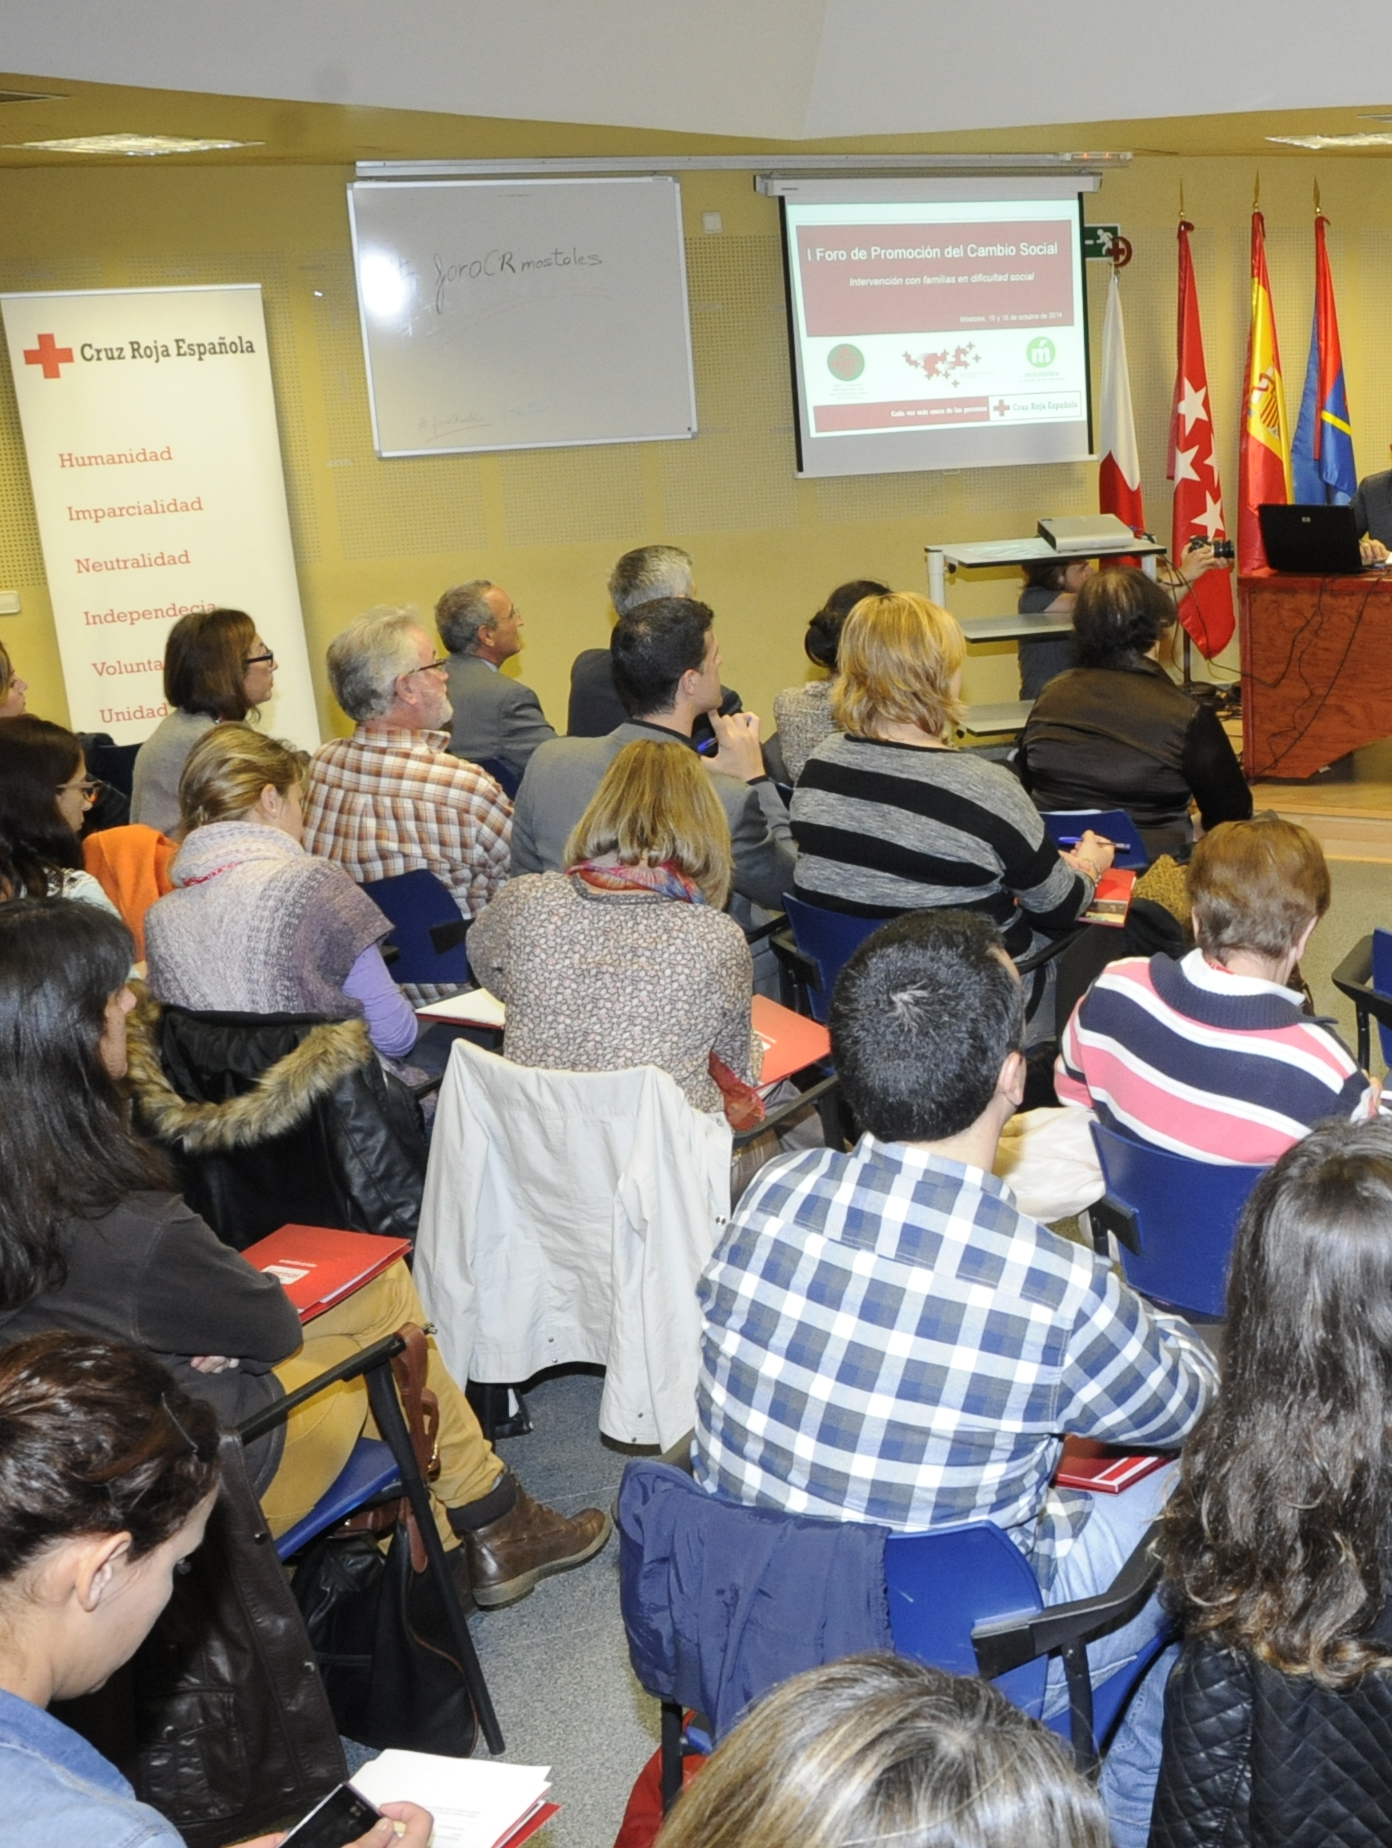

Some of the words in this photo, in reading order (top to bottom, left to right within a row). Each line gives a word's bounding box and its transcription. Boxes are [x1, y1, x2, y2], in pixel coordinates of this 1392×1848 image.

[816, 248, 846, 261] Foro
[851, 248, 867, 260] de
[871, 246, 940, 260] Promoción
[944, 244, 964, 258] del
[967, 243, 1016, 257] Cambio
[1020, 242, 1058, 256] Social
[850, 276, 902, 287] Intervención
[905, 277, 920, 285] con
[923, 274, 955, 284] familias
[970, 272, 1008, 283] dificultad
[1010, 272, 1035, 282] social
[80, 343, 126, 362] Cruz
[129, 340, 170, 363] Roja
[174, 336, 256, 361] Española
[58, 446, 173, 468] Humanidad
[67, 497, 204, 524] Imparcialidad
[76, 550, 191, 574] Neutralidad
[92, 659, 164, 677] Volunta
[100, 703, 169, 724] Unidad
